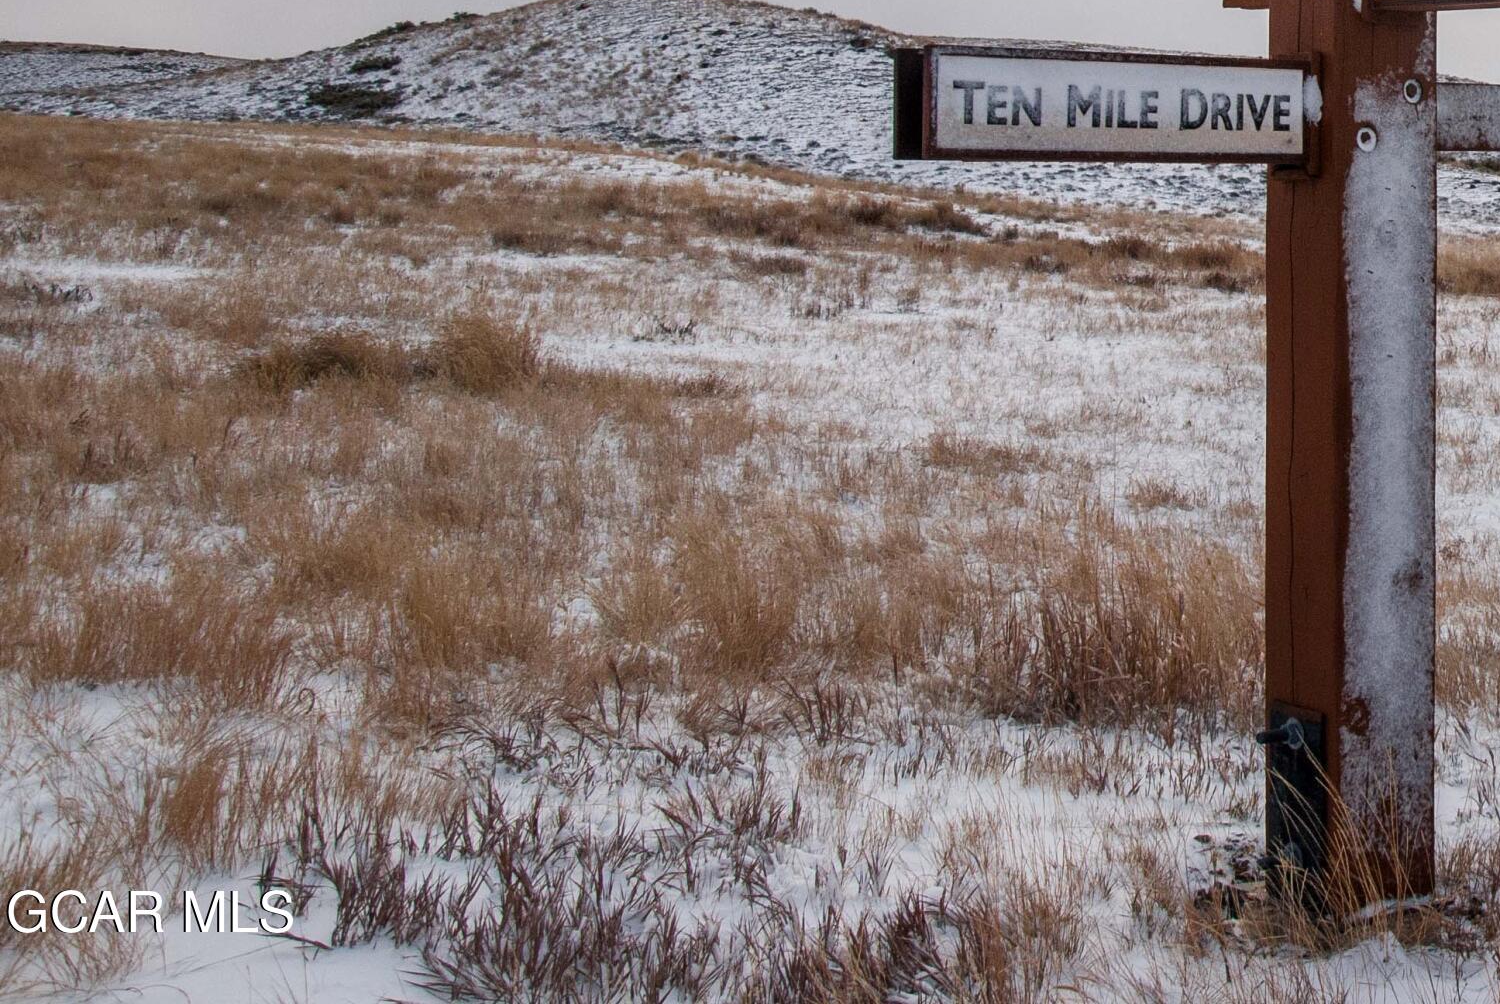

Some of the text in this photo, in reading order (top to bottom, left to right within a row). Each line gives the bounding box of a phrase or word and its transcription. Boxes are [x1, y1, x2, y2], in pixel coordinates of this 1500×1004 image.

[952, 80, 1291, 132] TEN MILE DRIVE
